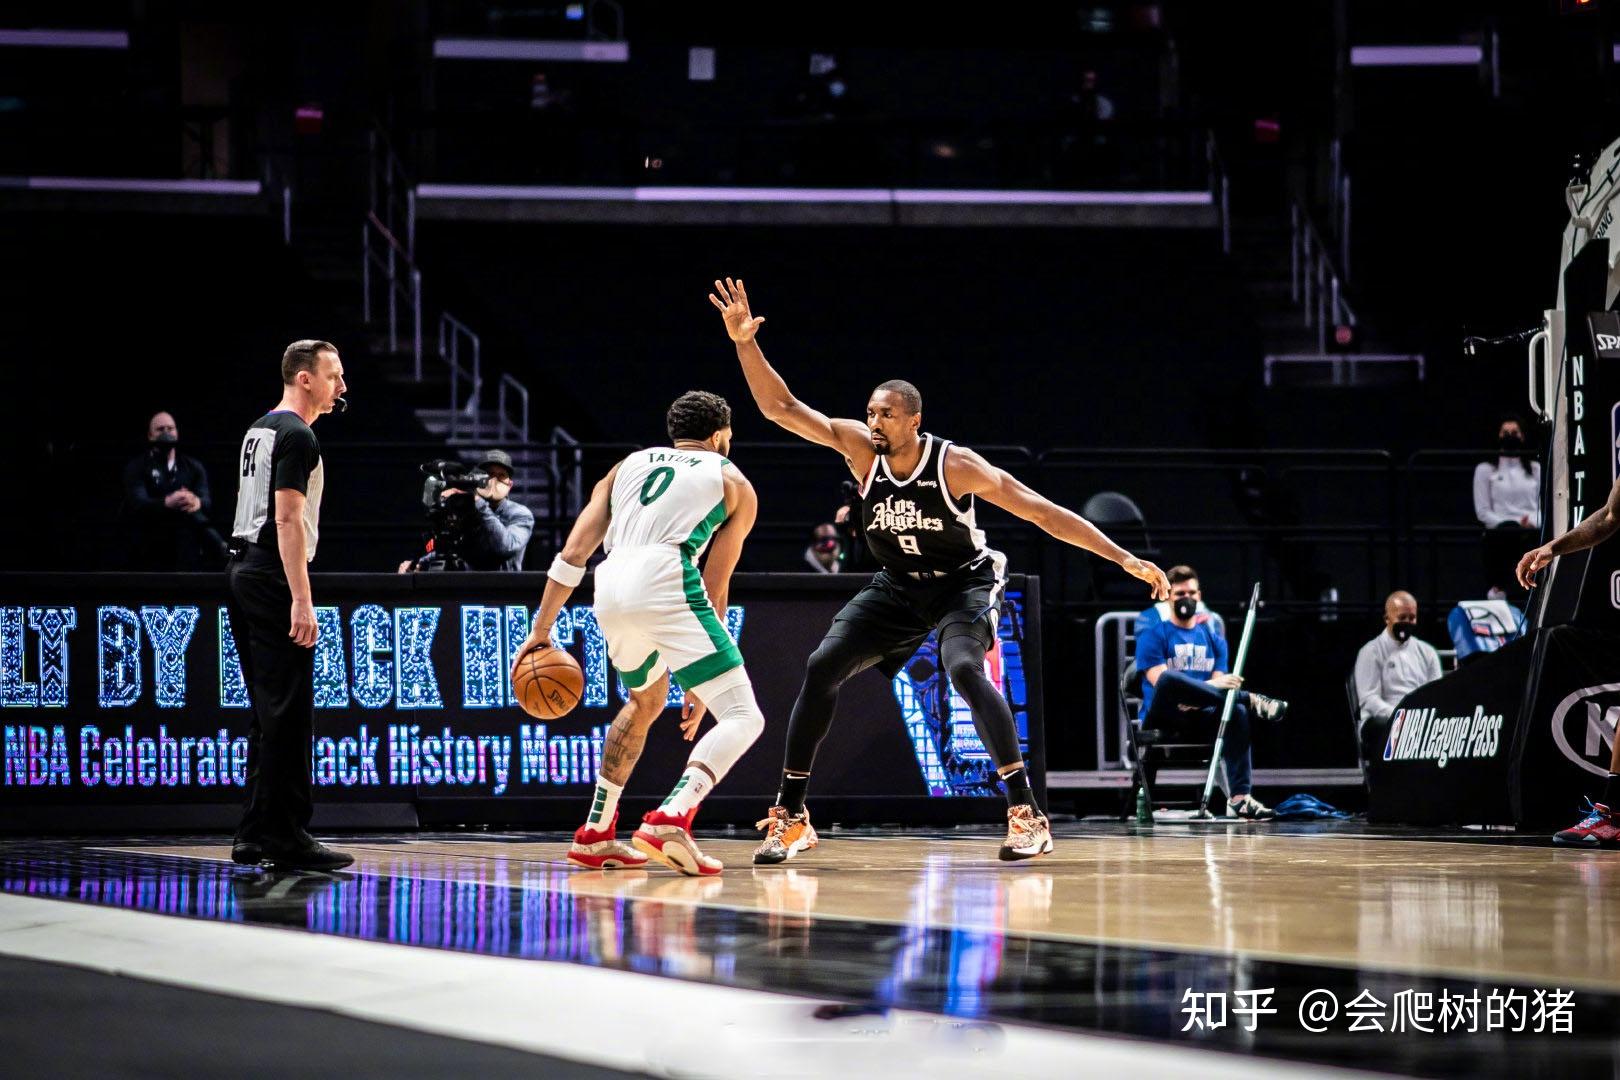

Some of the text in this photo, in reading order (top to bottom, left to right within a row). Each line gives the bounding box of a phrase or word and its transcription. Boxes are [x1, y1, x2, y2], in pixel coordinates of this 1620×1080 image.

[1571, 355, 1585, 455] NBA
[648, 452, 702, 467] TATUM
[639, 466, 675, 506] 0
[885, 494, 917, 516] Los
[866, 502, 944, 535] Angeles
[897, 535, 922, 556] 9
[98, 606, 200, 708] BY
[218, 605, 443, 709] ACK
[1394, 705, 1503, 768] NBA League Pass
[4, 724, 612, 796] NBA Celebrate ack History Mont
